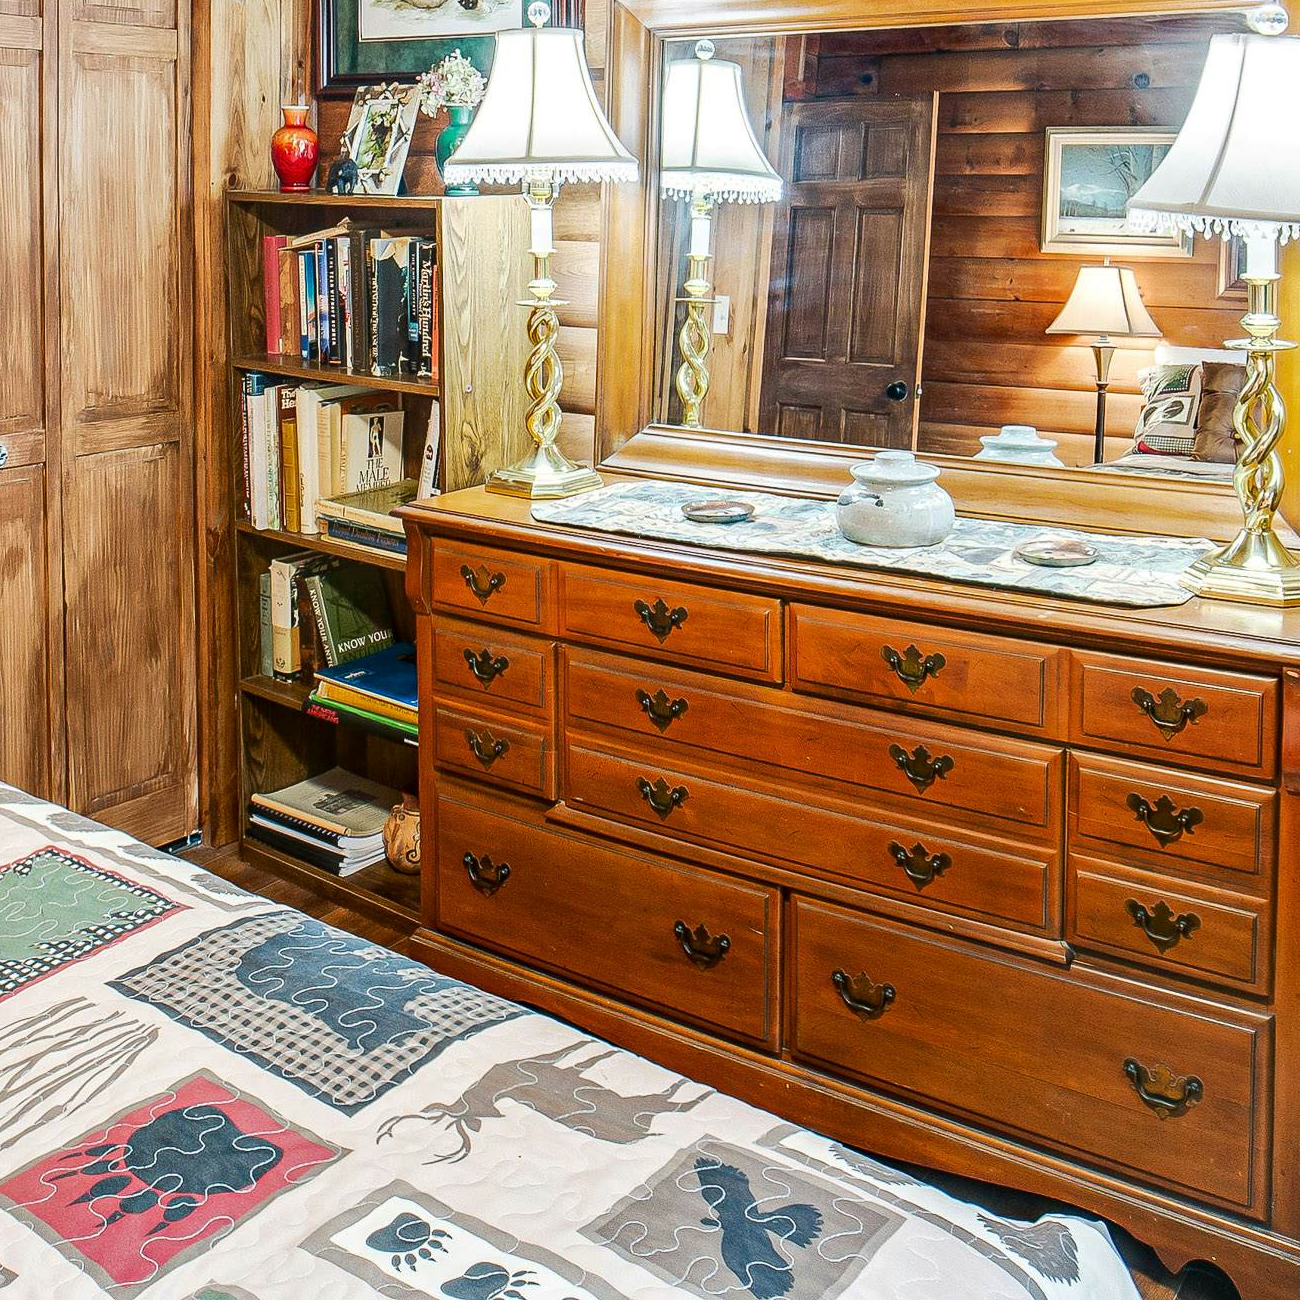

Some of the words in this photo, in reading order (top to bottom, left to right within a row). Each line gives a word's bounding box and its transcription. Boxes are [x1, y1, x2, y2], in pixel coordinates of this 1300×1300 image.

[420, 260, 433, 306] Martin's
[421, 306, 432, 357] Hundred
[281, 389, 297, 399] The
[366, 458, 384, 470] THE
[359, 467, 390, 484] MALE
[309, 588, 322, 617] KNOW
[316, 616, 328, 643] YOUR
[337, 635, 366, 654] KNOW
